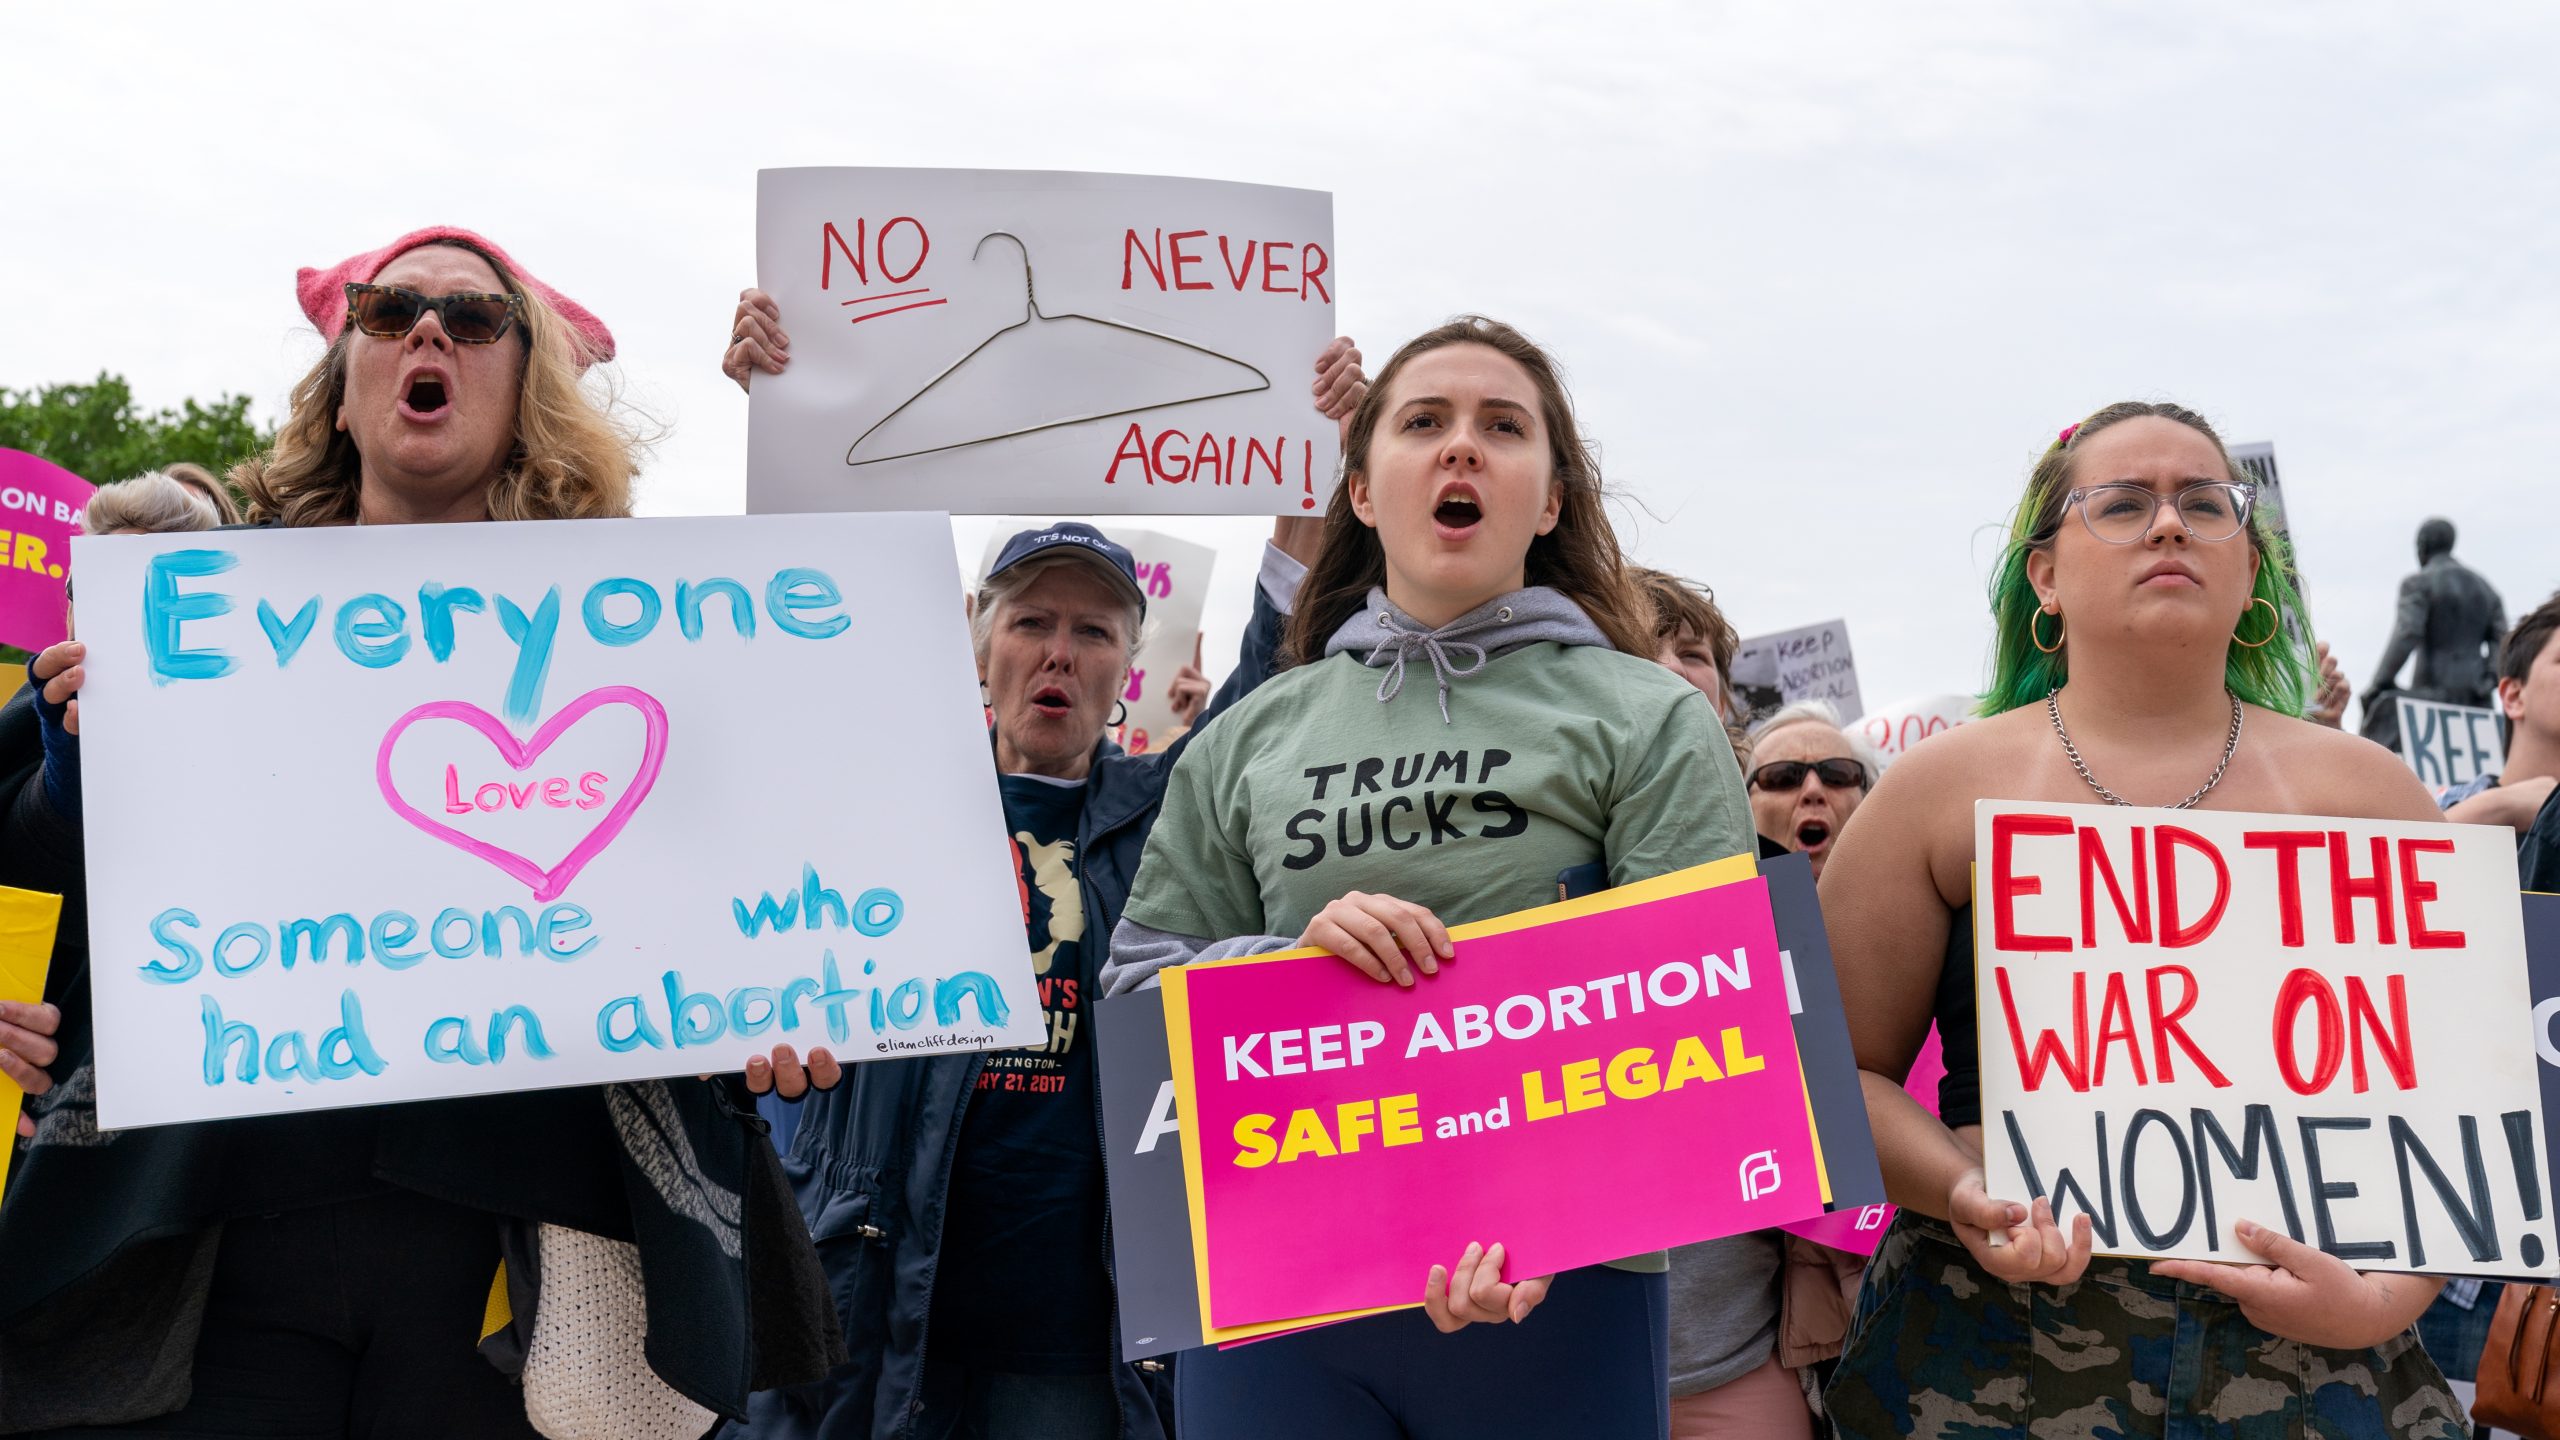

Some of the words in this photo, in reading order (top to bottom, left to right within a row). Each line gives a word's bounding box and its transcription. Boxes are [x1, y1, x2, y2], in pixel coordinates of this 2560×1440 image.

[822, 216, 930, 290] NO
[1121, 228, 1330, 304] NEVER
[1105, 422, 1316, 511] AGAIN!
[1062, 534, 1090, 543] NOT
[141, 548, 852, 726] Everyone
[1782, 651, 1854, 693] ABORTION
[1304, 748, 1513, 801] TRUMP
[2404, 703, 2505, 786] KEE
[445, 764, 608, 815] Loves
[1281, 790, 1529, 870] SUCKS
[732, 863, 904, 940] who
[1991, 812, 2232, 953] END
[2243, 829, 2467, 950] THE
[201, 988, 388, 1087] had
[423, 1003, 558, 1066] an
[596, 948, 1011, 1054] abortion
[876, 1033, 995, 1053] @liamcliffdesign
[1223, 1021, 1386, 1081] KEEP
[1405, 947, 1751, 1059] ABORTION
[1994, 963, 2234, 1093] WAR
[2271, 967, 2419, 1096] ON
[1004, 1073, 1026, 1092] 21,
[1030, 1074, 1066, 1092] 2017
[1233, 1093, 1423, 1168] SAFE
[1436, 1097, 1510, 1139] and
[1522, 1027, 1766, 1122] LEGAL
[2003, 1103, 2545, 1268] WOMEN!
